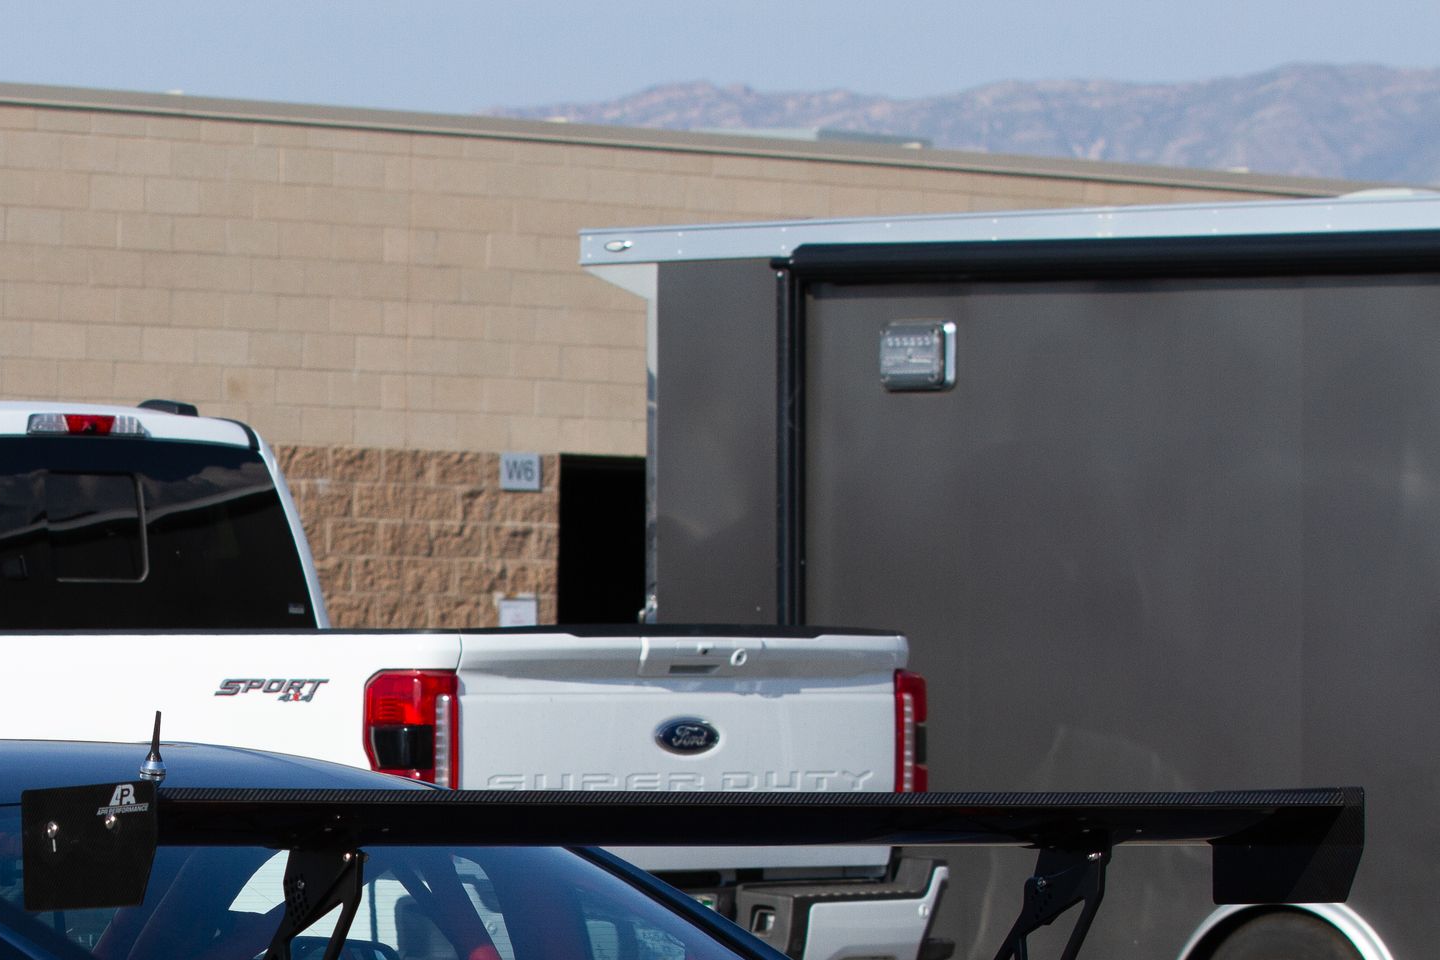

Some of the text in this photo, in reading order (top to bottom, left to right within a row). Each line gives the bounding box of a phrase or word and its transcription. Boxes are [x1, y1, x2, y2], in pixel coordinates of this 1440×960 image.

[505, 459, 535, 482] W6
[214, 678, 330, 698] SPORT
[671, 726, 708, 747] Ford
